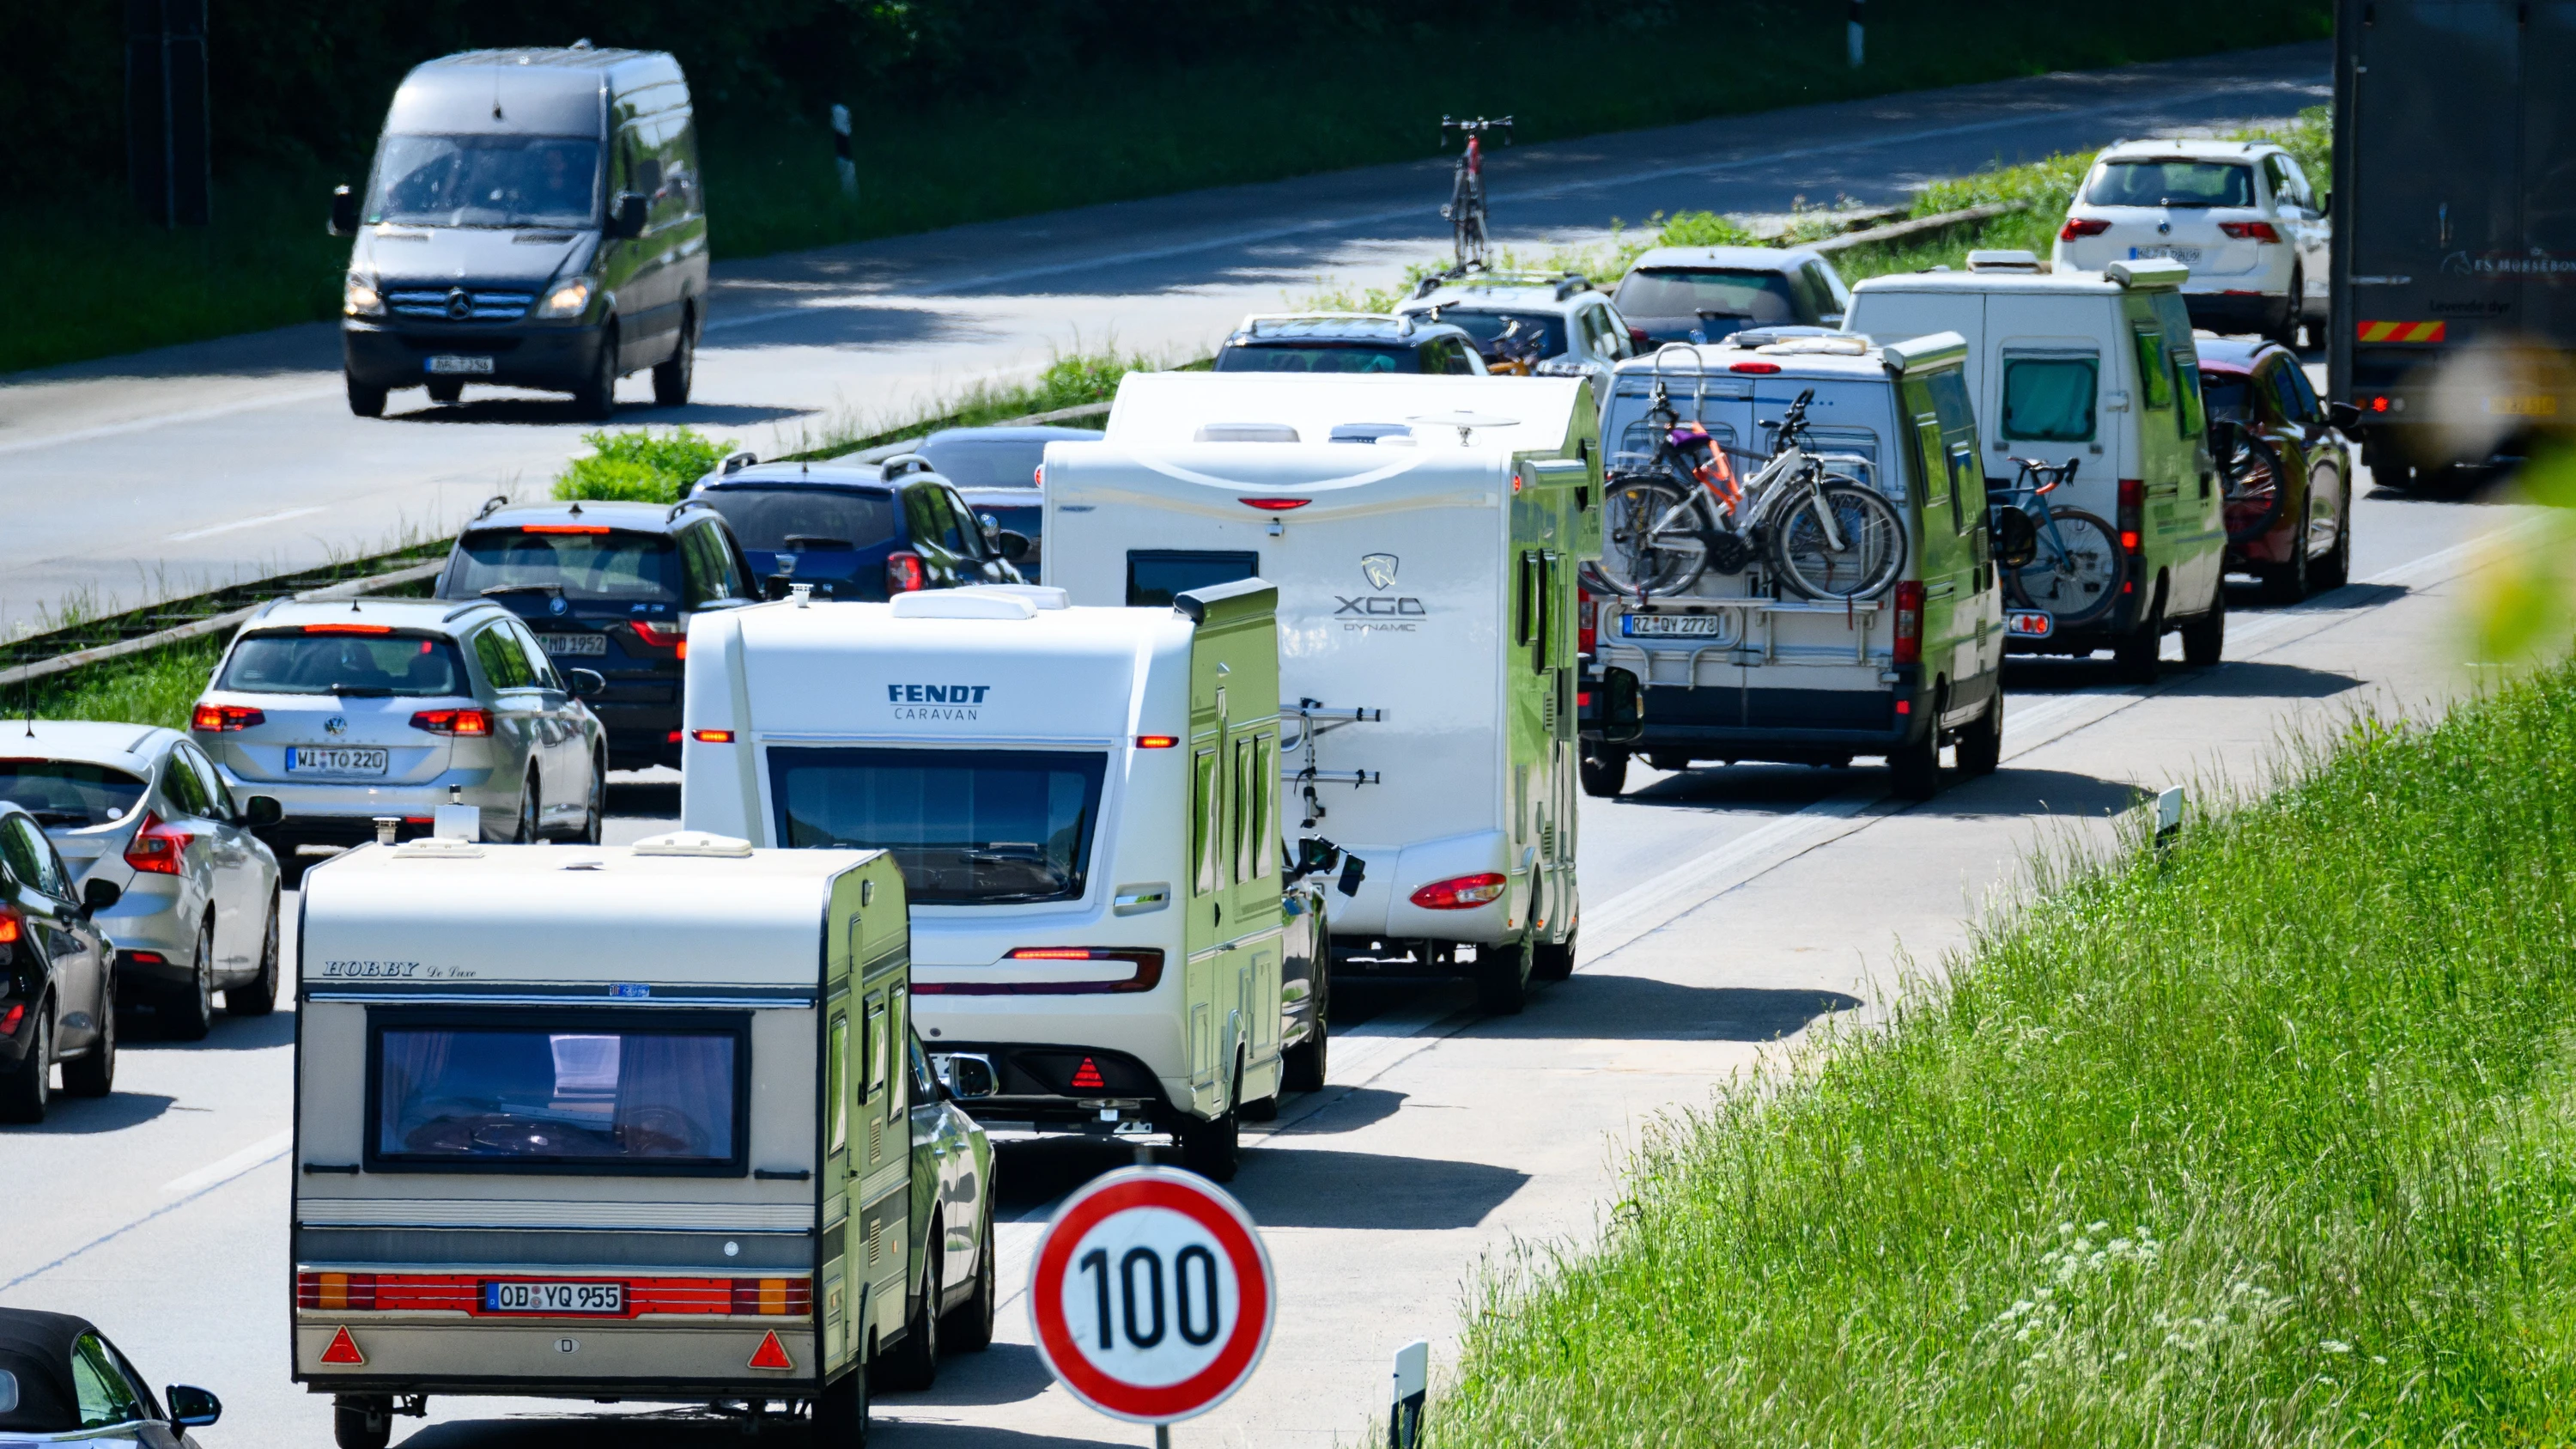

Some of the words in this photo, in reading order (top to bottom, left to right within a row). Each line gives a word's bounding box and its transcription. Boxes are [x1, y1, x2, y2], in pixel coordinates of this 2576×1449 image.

[1334, 595, 1425, 615] XGO
[1344, 623, 1416, 632] DYNAMIC
[1633, 617, 1649, 632] RZ
[1661, 618, 1678, 633] QY
[570, 636, 604, 652] 1952
[888, 684, 991, 703] FENDT
[894, 707, 977, 721] CARAVAN
[298, 751, 317, 767] WI
[328, 751, 350, 768] TO
[353, 750, 383, 768] 220
[322, 960, 420, 977] HOBBY
[427, 965, 444, 978] De
[501, 1285, 529, 1307] OD
[544, 1286, 573, 1307] YQ
[578, 1286, 619, 1308] 955
[1080, 1243, 1220, 1350] 100
[561, 1338, 574, 1353] D
